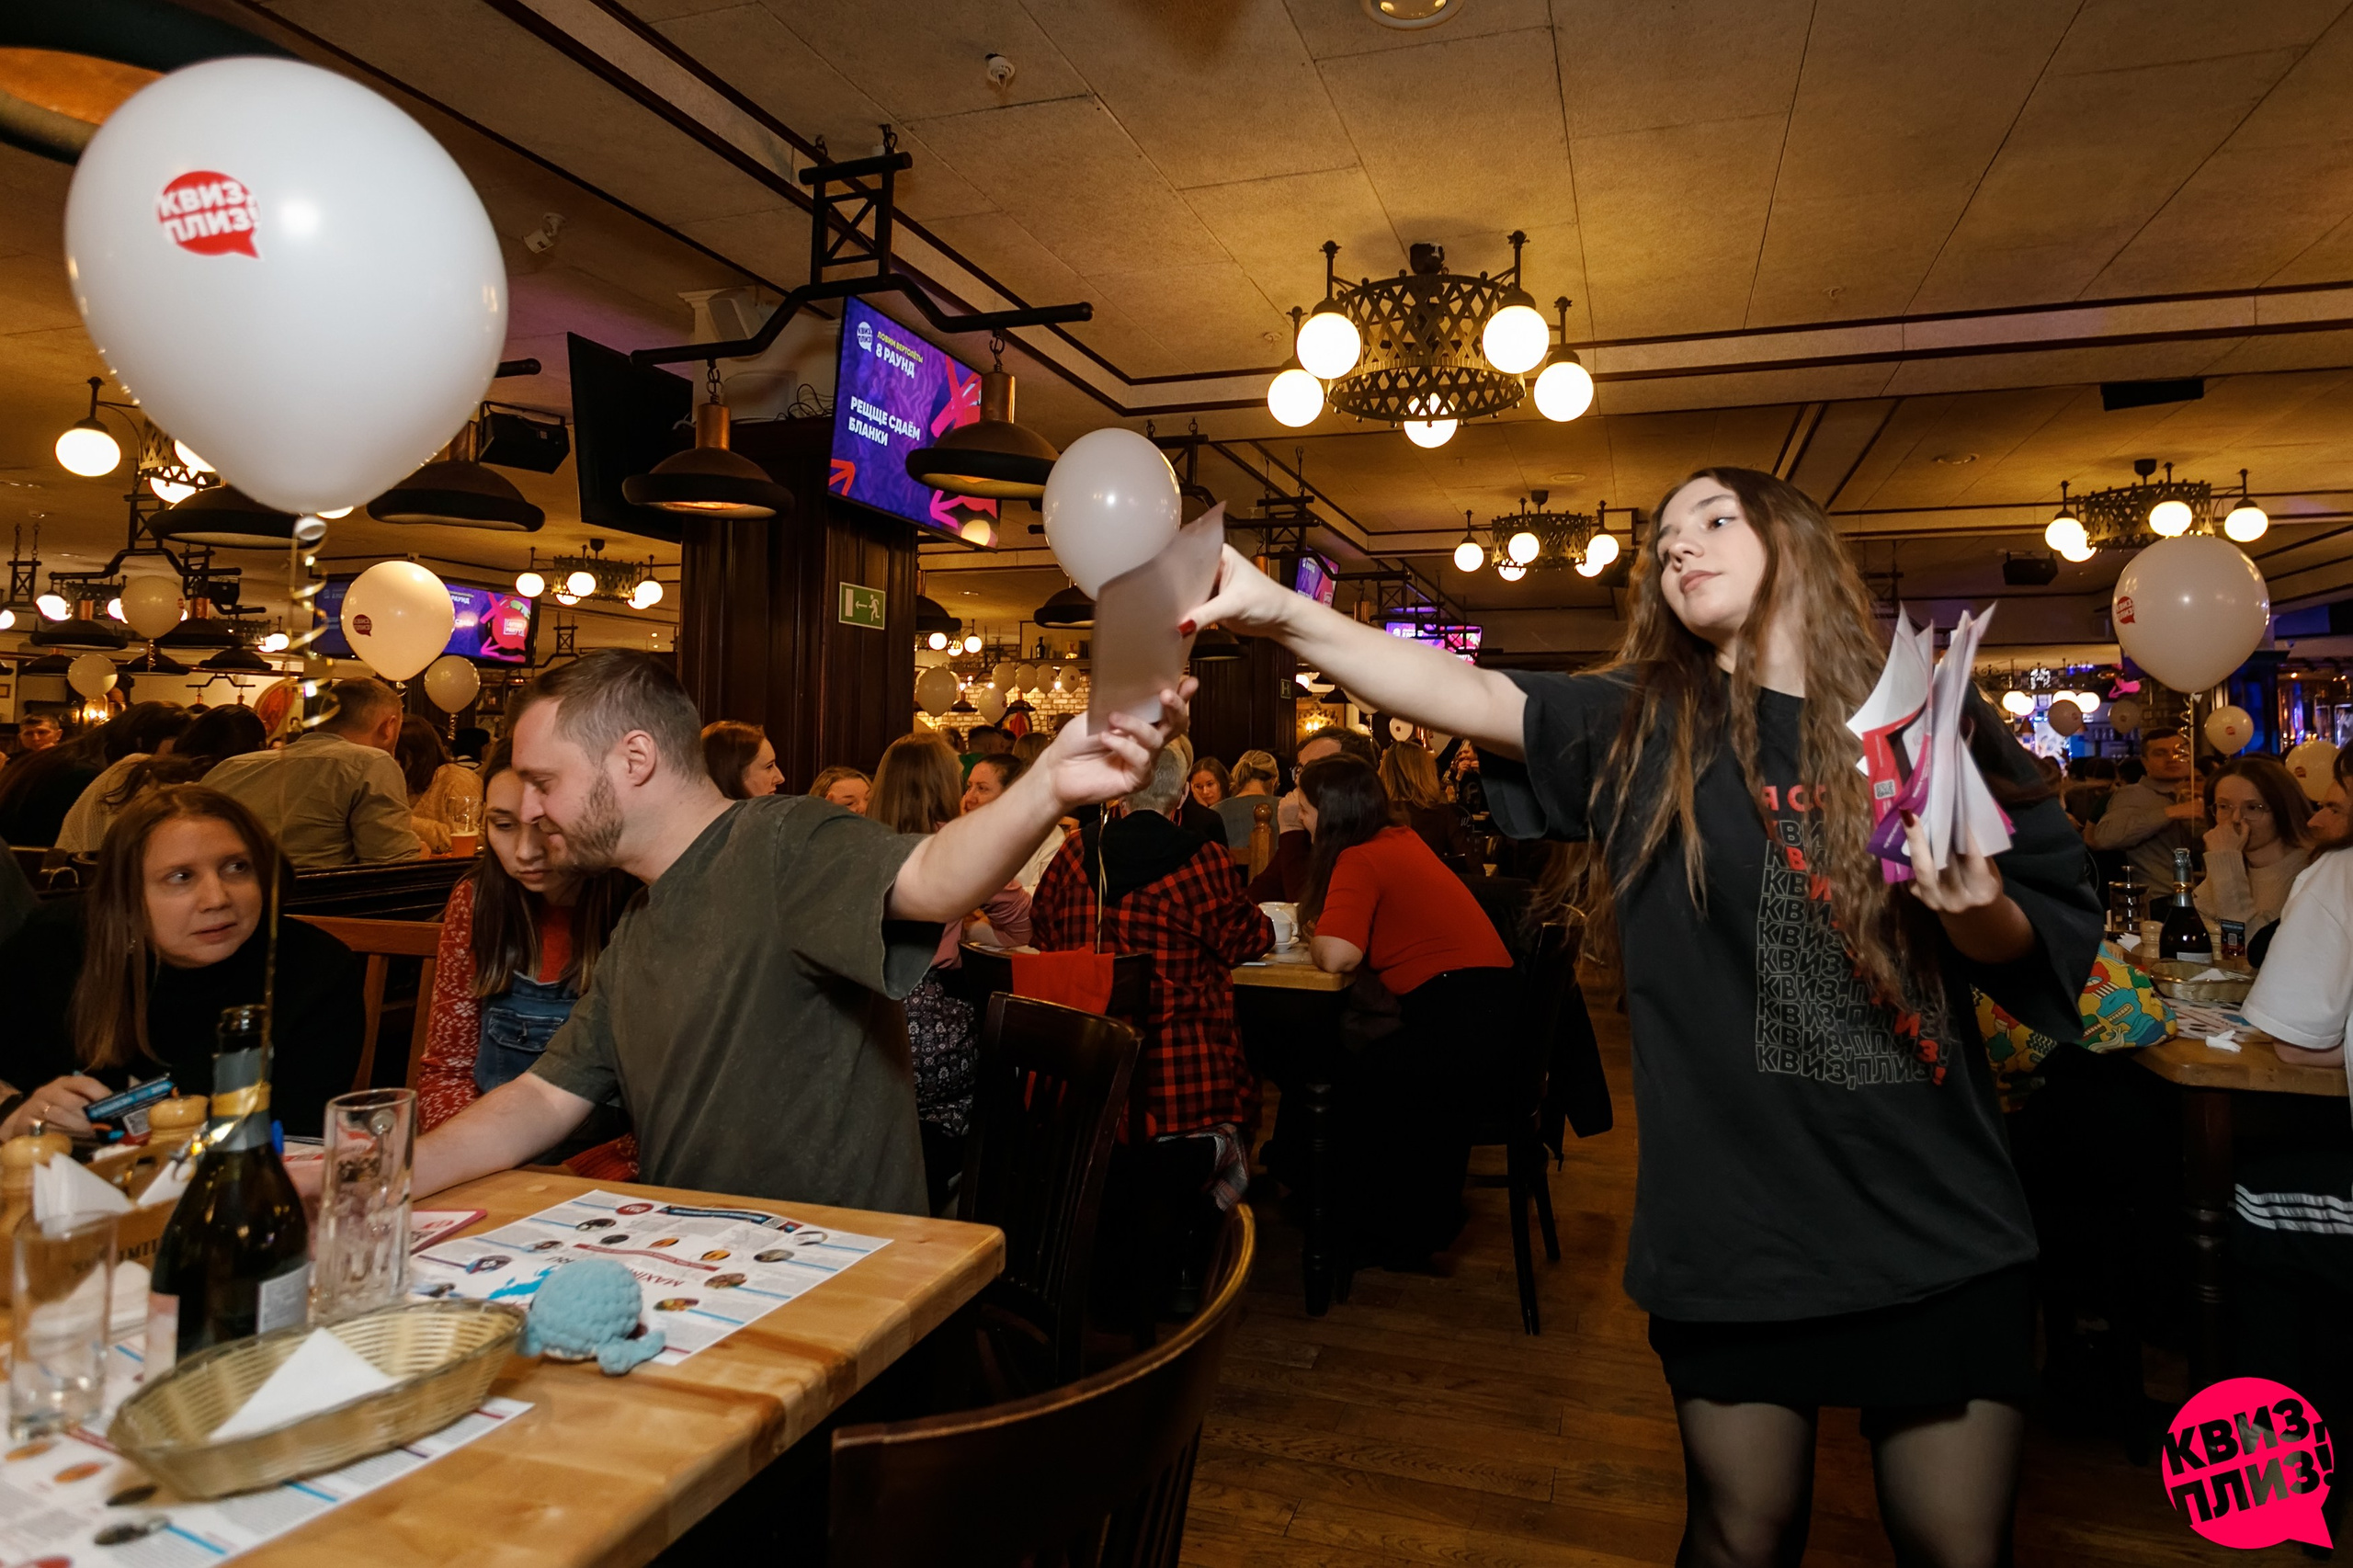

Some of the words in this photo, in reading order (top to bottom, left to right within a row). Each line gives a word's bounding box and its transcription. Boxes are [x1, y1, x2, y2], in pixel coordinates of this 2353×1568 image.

[876, 343, 883, 358] 8
[883, 347, 915, 379] РАУНД
[848, 416, 889, 447] БЛАНКИ
[850, 395, 889, 426] РЕЩЩЕ
[889, 415, 921, 441] СДАЁМ
